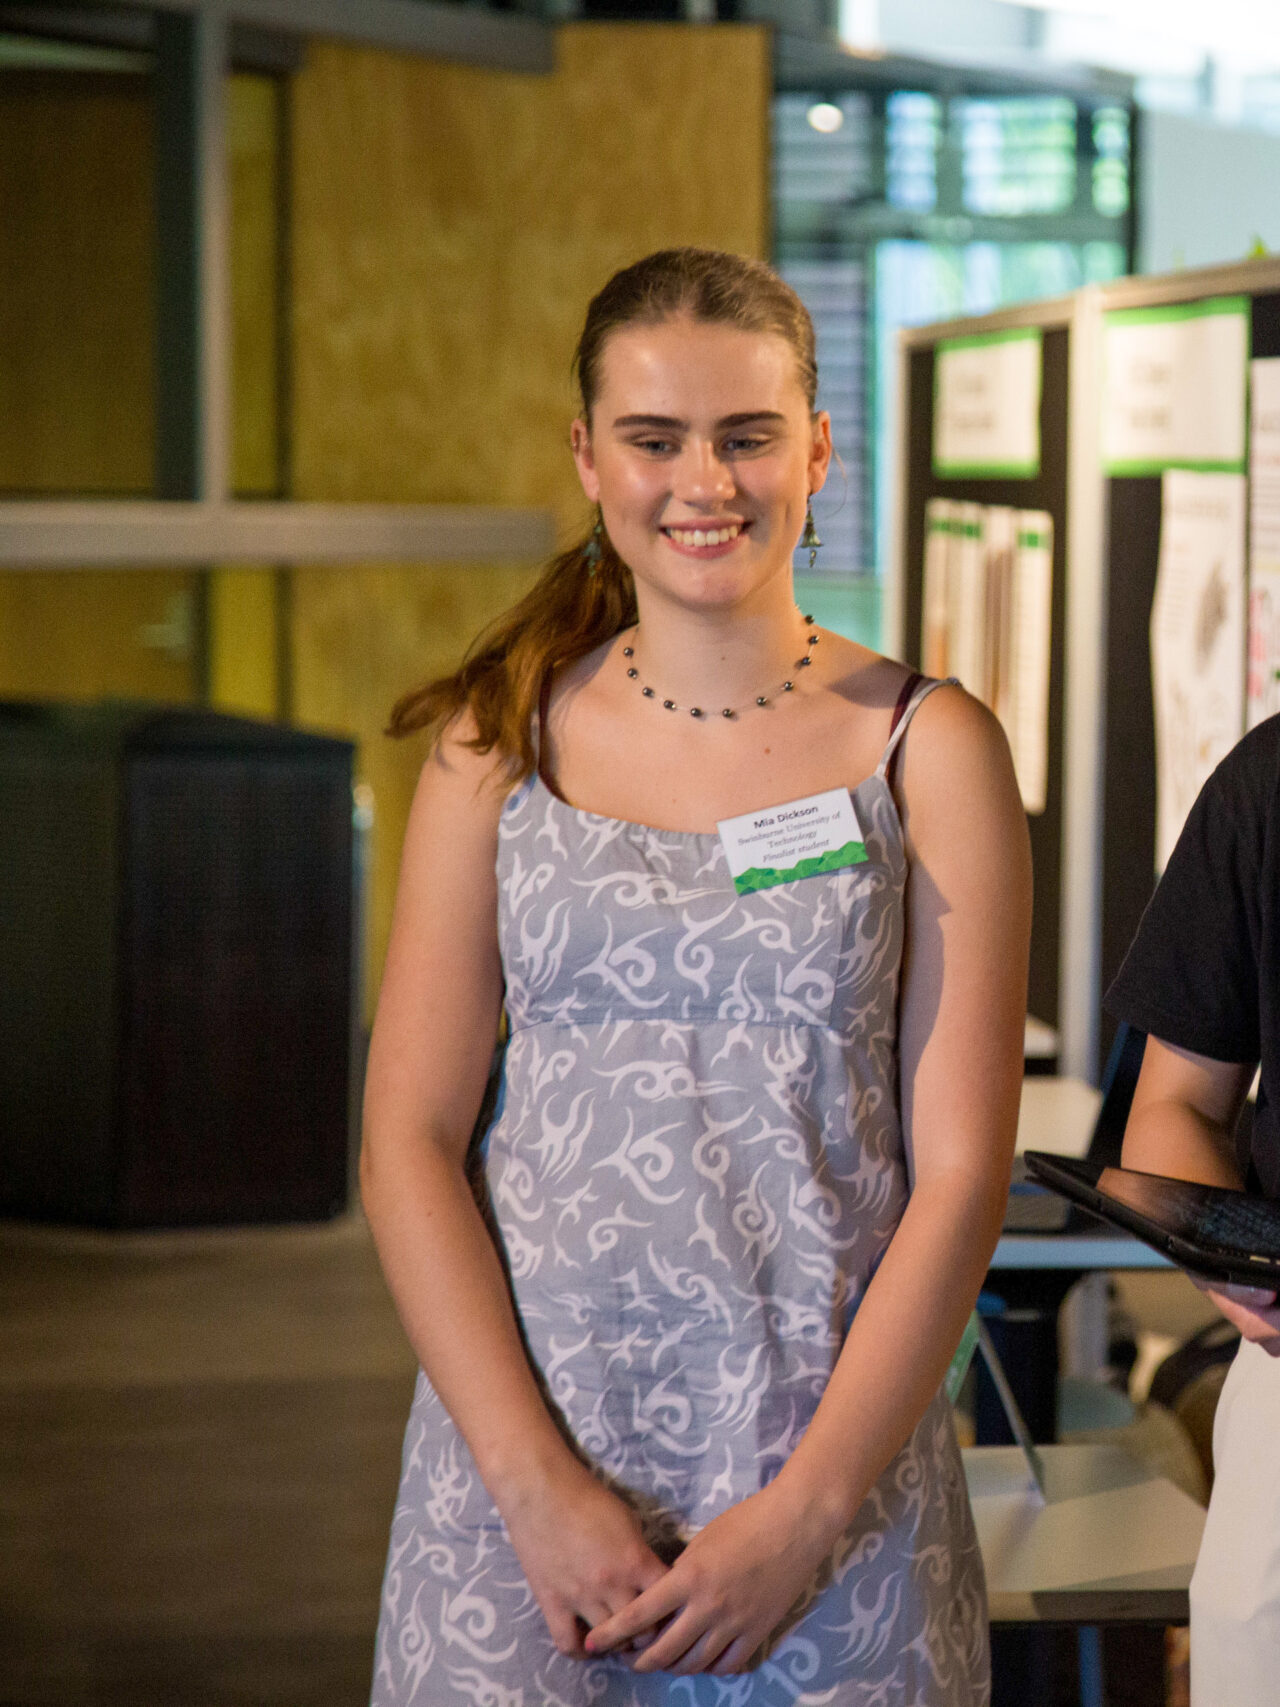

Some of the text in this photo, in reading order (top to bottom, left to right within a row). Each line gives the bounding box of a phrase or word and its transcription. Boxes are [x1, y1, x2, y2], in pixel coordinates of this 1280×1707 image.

[737, 811, 841, 846] Swinburne University of
[754, 806, 819, 829] Mia Dickson
[763, 838, 830, 862] Finalist student
[767, 829, 817, 849] Technology
